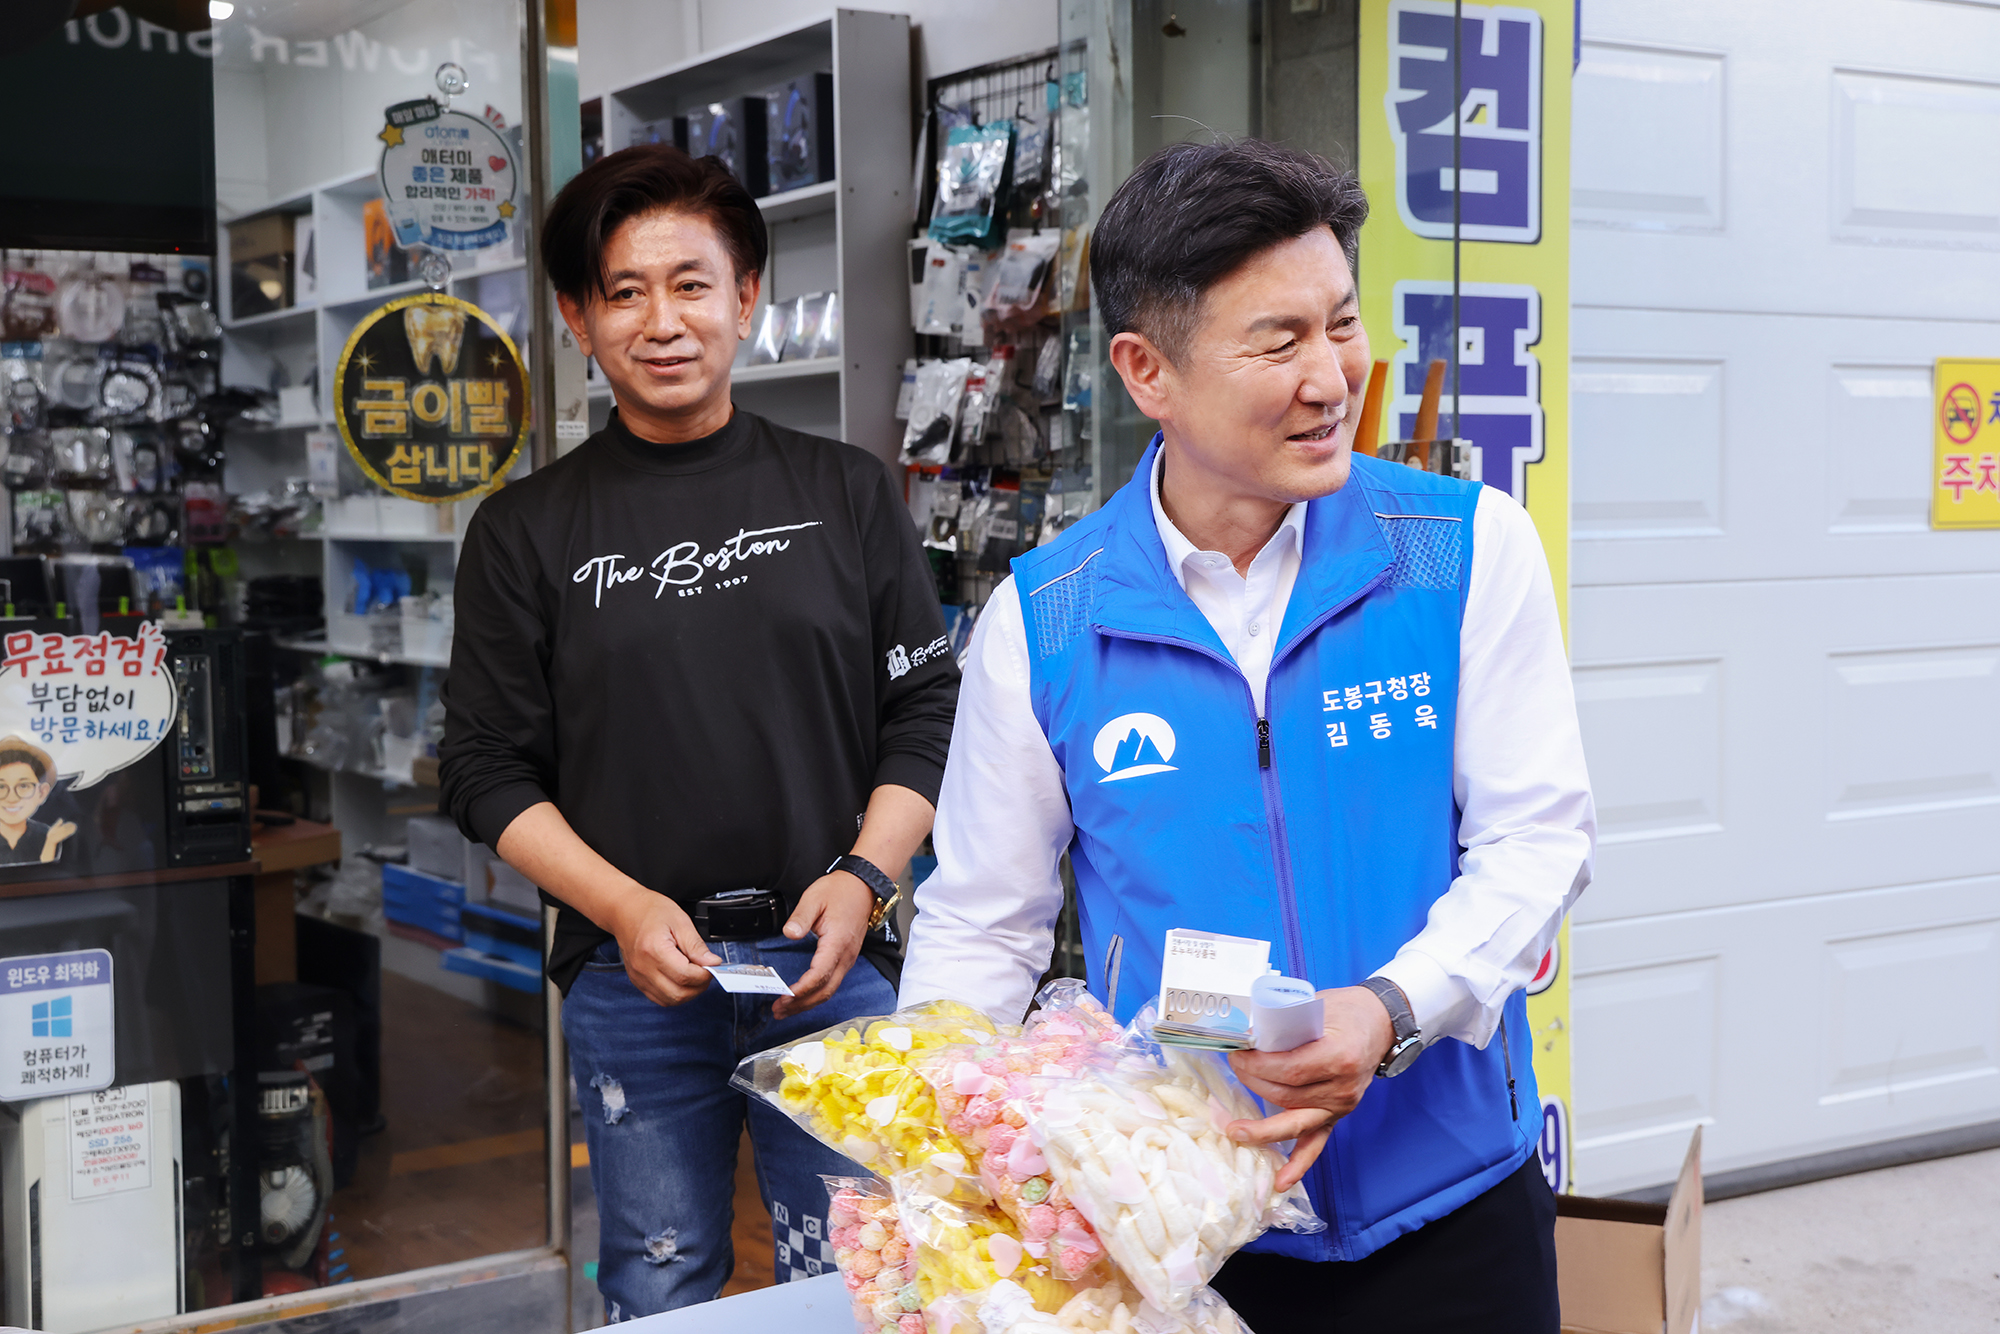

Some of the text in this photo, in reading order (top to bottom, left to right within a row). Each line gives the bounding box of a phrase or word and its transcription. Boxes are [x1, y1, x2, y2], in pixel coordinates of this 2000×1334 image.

[421, 149, 472, 166] 애터미
[411, 166, 483, 185] 좋은 제품
[405, 185, 496, 201] 합리적인 가격!
[355, 379, 510, 434] 금이빨
[385, 444, 494, 485] 삽니다
[572, 520, 823, 609] The Boston
[677, 585, 703, 597] EST
[2, 633, 165, 678] 무료점검!
[910, 634, 948, 667] Boston
[27, 682, 134, 713] 부담없이
[1322, 671, 1431, 713] 도봉구청장
[30, 717, 166, 744] 방문하세요!
[7, 960, 100, 989] 윈도우 최적화
[1167, 990, 1232, 1019] 10000
[23, 1044, 88, 1067] 컴퓨터가
[20, 1063, 91, 1085] 쾌적하게!
[95, 1109, 145, 1123] PEGATRON
[88, 1134, 133, 1149] SSD 256
